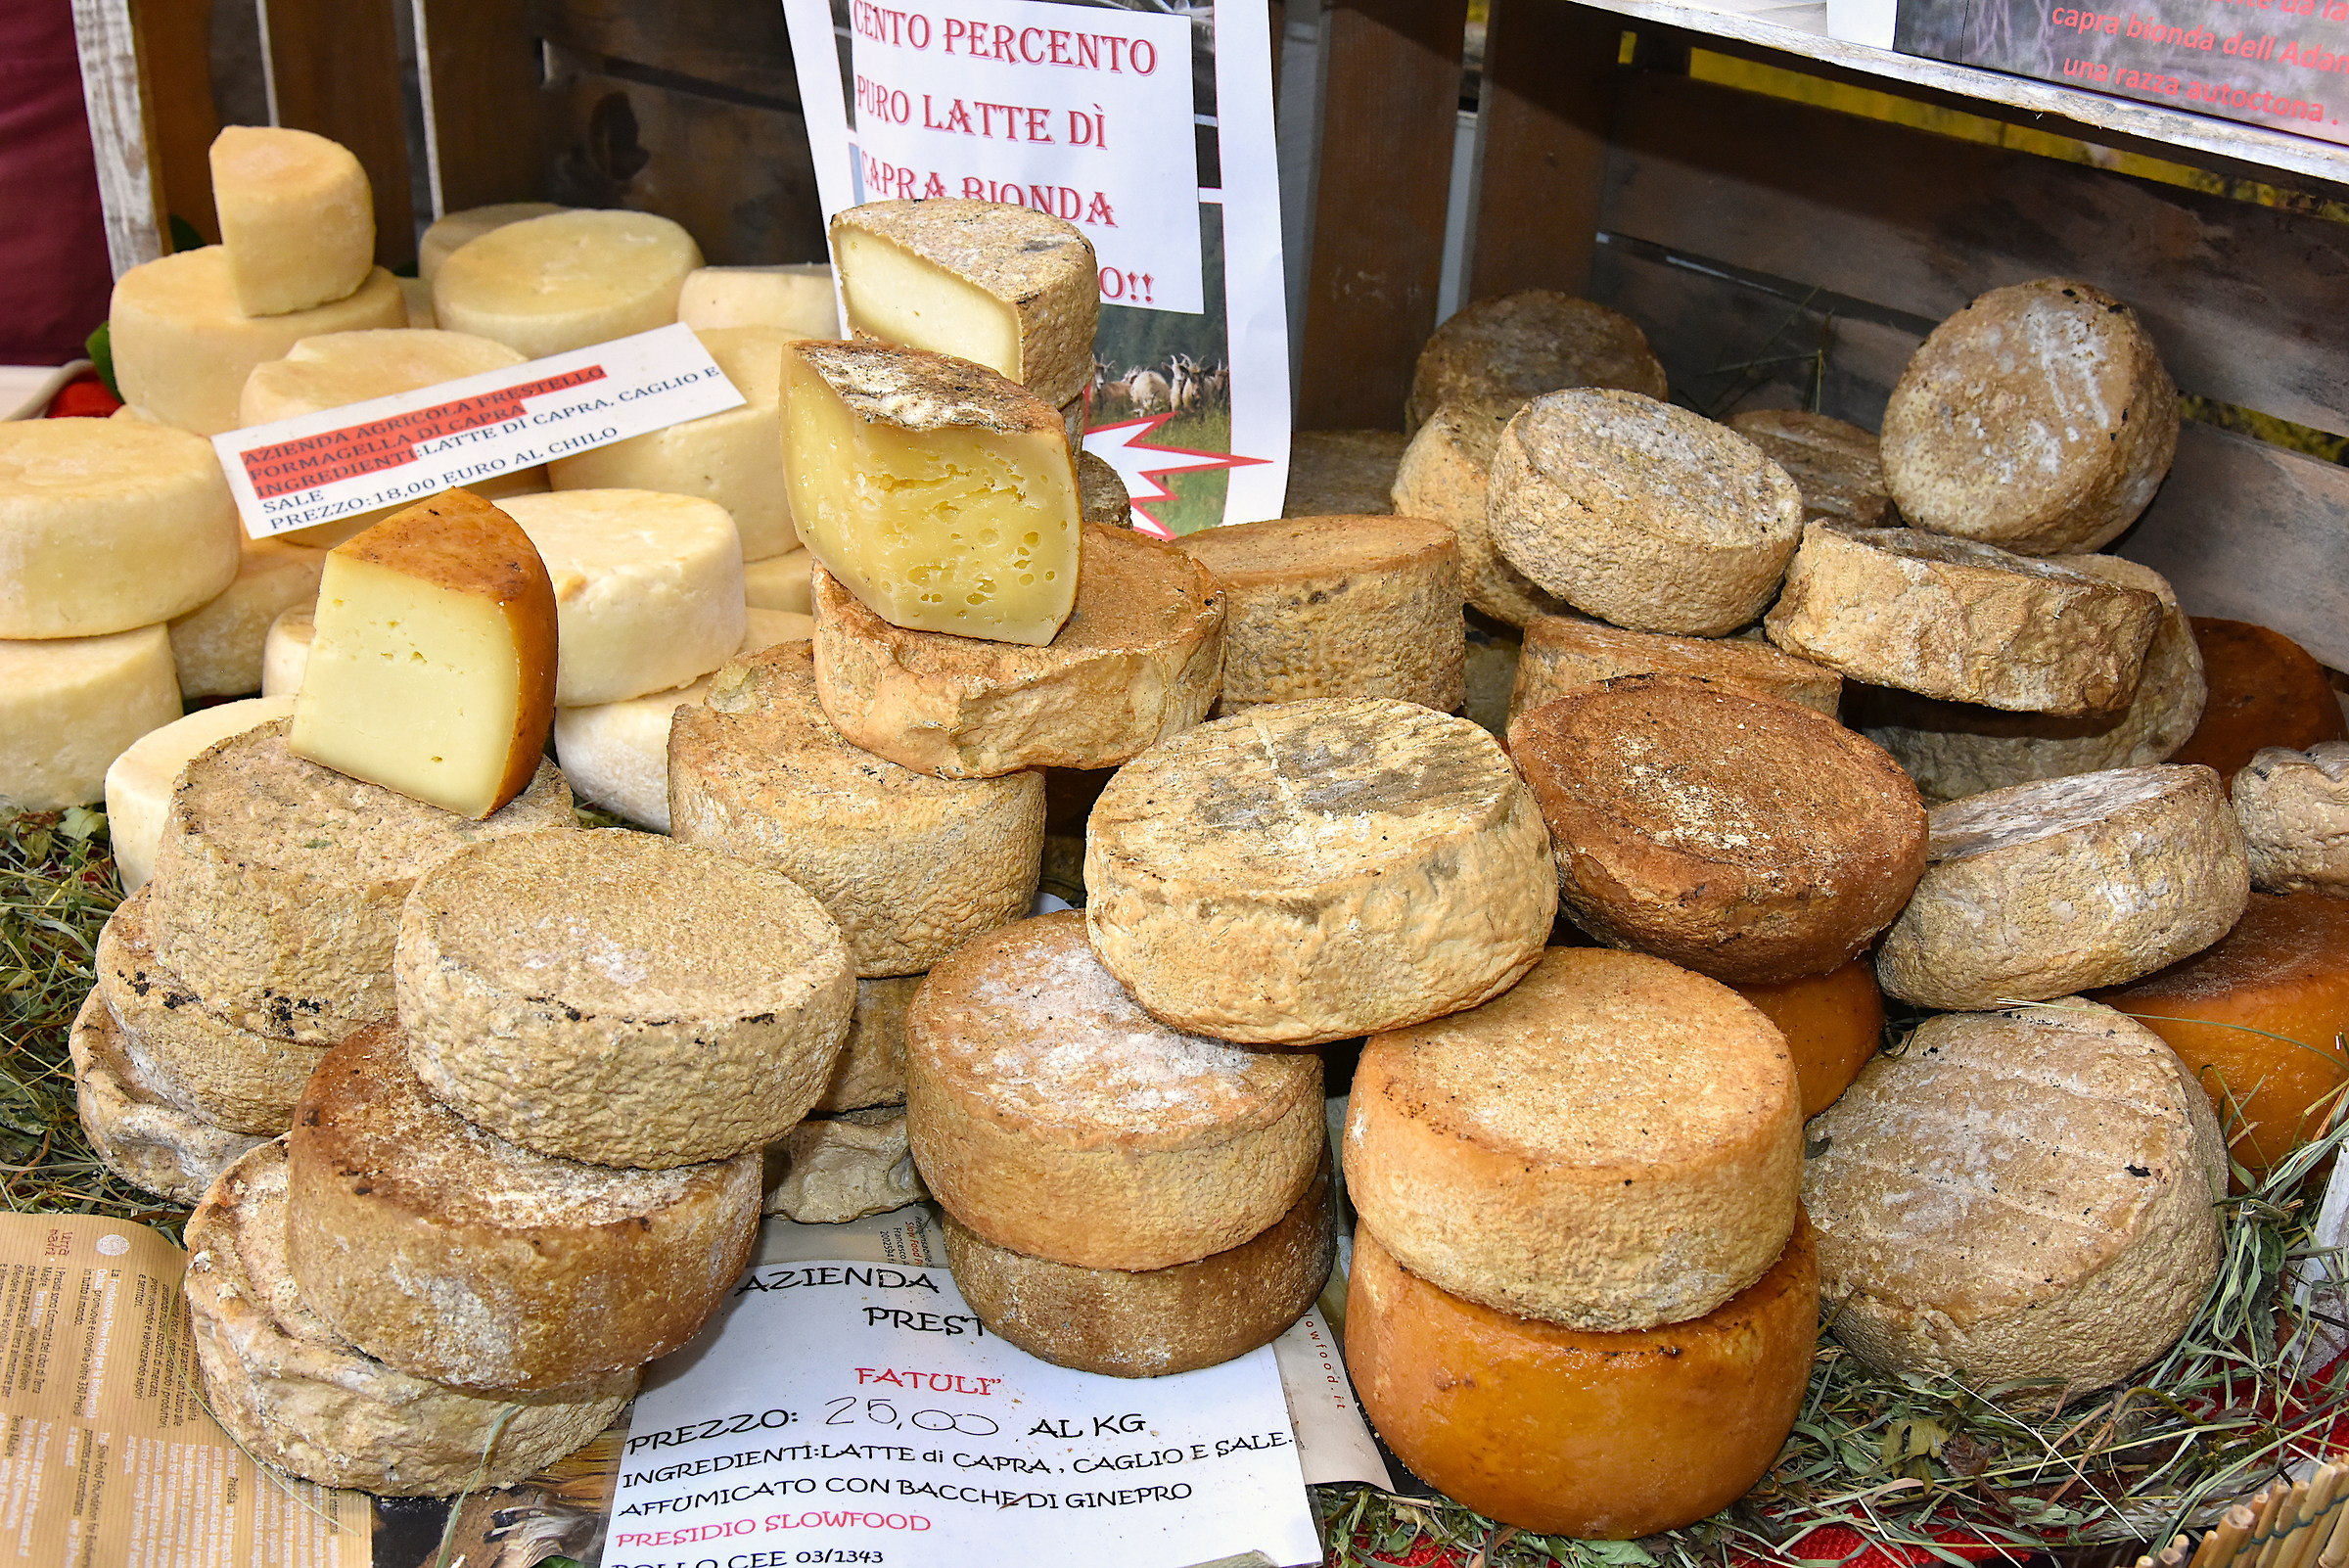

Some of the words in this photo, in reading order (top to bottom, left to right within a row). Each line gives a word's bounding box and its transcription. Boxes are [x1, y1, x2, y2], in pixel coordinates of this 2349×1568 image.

[853, 0, 931, 49] CENTO
[944, 18, 1159, 76] PERCENTO
[2052, 6, 2119, 35] capra
[2126, 13, 2216, 52] bionda
[2223, 30, 2276, 62] dell
[2063, 57, 2109, 82] una
[2115, 67, 2180, 96] razza
[2187, 80, 2325, 122] autoctona
[856, 74, 910, 125] PURO
[923, 94, 1055, 144] LATTE
[1067, 103, 1108, 151] DÌ
[861, 151, 947, 200] CAPRA
[962, 176, 1119, 228] BIONDA
[619, 372, 699, 403] CAGLIO
[704, 365, 720, 378] E
[244, 431, 349, 466] AZIENDA
[351, 401, 471, 438] AGRICOLA
[478, 365, 605, 408] PRESTELLO
[250, 434, 413, 482] FORMAGELLA
[448, 403, 527, 431] CAPRA
[442, 457, 507, 485] EURO
[514, 449, 544, 465] AL
[548, 426, 619, 453] CHILO
[262, 489, 324, 514] SALE
[894, 1227, 907, 1259] Francesco
[910, 1239, 920, 1257] Food
[112, 1268, 121, 1277] La
[734, 1267, 940, 1297] AZIENDA
[627, 1408, 799, 1455] PREZZO:
[1028, 1419, 1083, 1439] AL
[1093, 1413, 1146, 1437] KG
[922, 1450, 944, 1464] di
[1073, 1448, 1183, 1474] CAGLIO
[1191, 1445, 1210, 1460] E
[1216, 1431, 1294, 1458] SALE.
[619, 1478, 817, 1517] AFFUMICATO
[825, 1477, 891, 1495] CON
[897, 1479, 1019, 1506] BACCHE
[1028, 1493, 1060, 1509] DI
[1066, 1483, 1192, 1508] GINEPRO
[616, 1519, 756, 1548] PRESIDIO
[765, 1511, 931, 1534] SLOWFOOD
[728, 1550, 787, 1568] CEE
[795, 1548, 884, 1564] 03/1343
